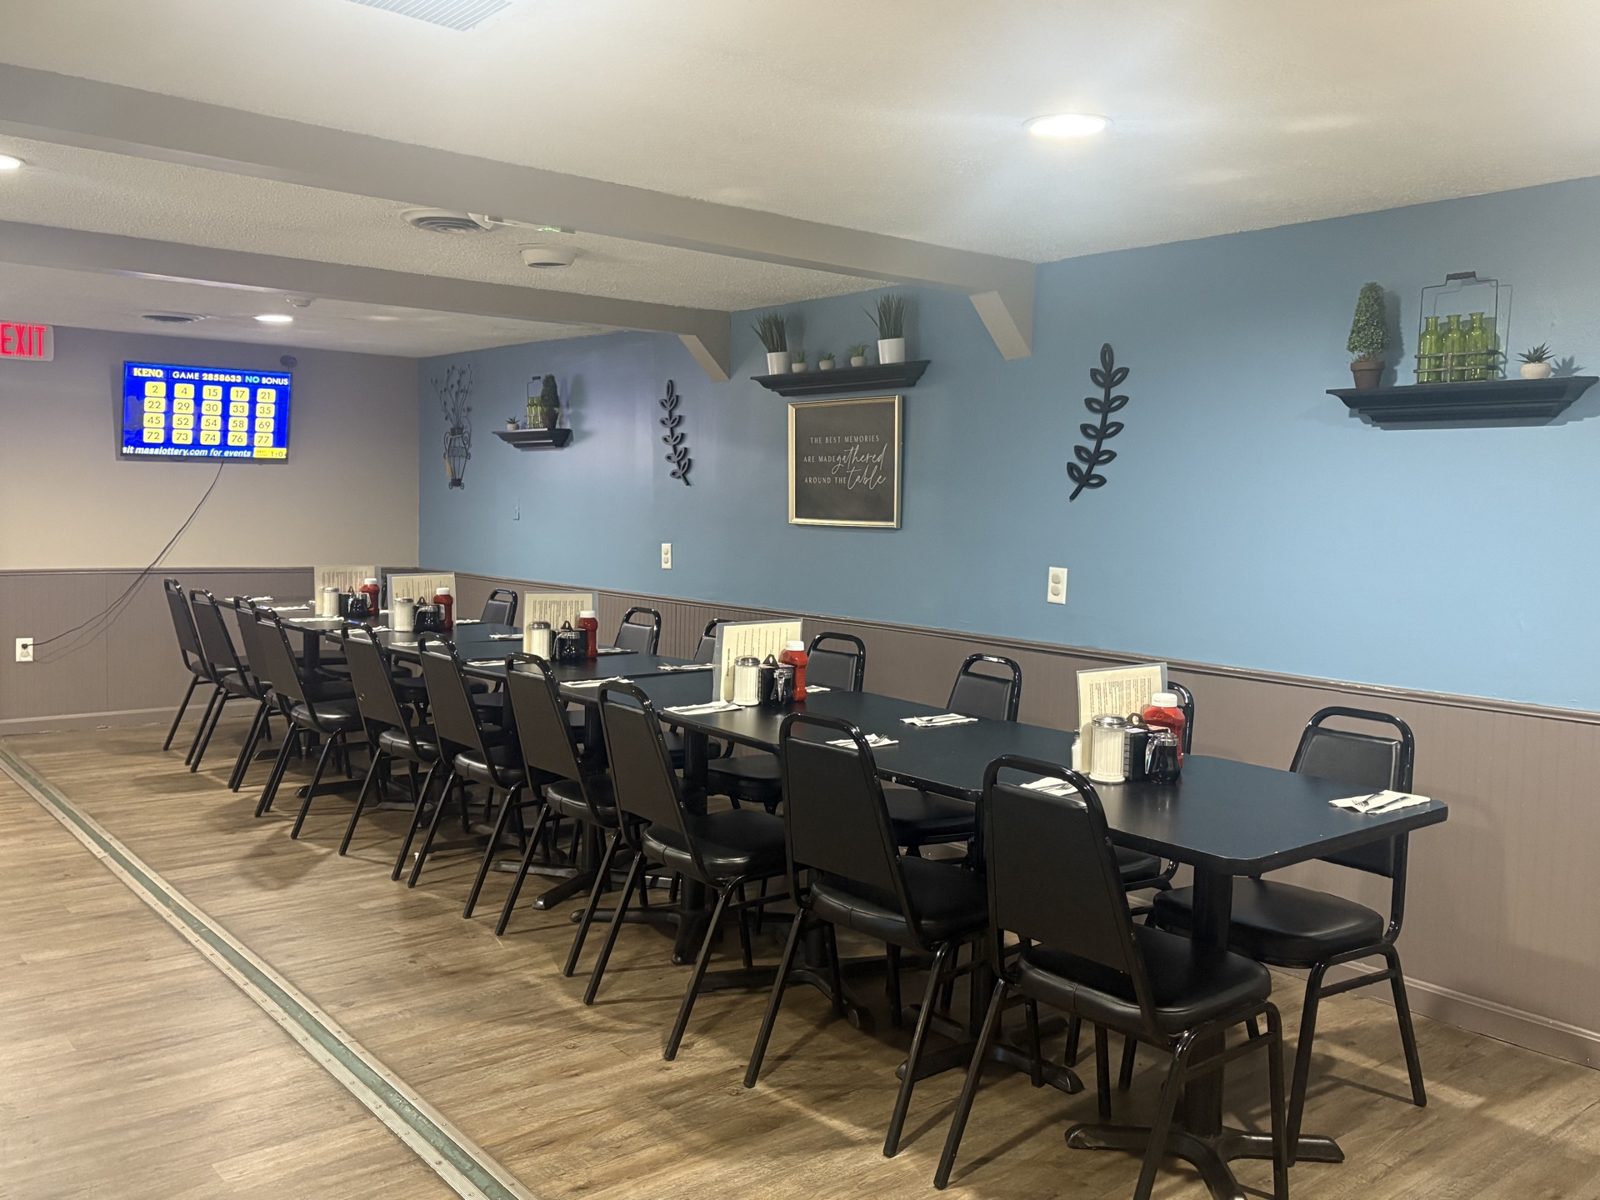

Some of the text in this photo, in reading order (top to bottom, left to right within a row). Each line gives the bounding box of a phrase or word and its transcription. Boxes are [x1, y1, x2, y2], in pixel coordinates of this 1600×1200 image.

[0, 322, 47, 358] EXIT
[133, 367, 163, 378] KENO
[172, 371, 289, 385] GAME 2858633 NO BONUS
[152, 385, 270, 400] 2 4 15 17 21
[148, 401, 271, 415] 22 29 30 33 35
[147, 416, 271, 430] 45 52 54 58 69
[147, 431, 270, 444] 72 73 74 76 77
[810, 434, 880, 445] THE BEST MEMORIES
[135, 446, 208, 457] masslottery.com
[210, 448, 222, 458] for
[223, 449, 252, 458] events
[803, 443, 888, 475] ARE MADE gathered
[804, 464, 887, 490] AROUND THE table
